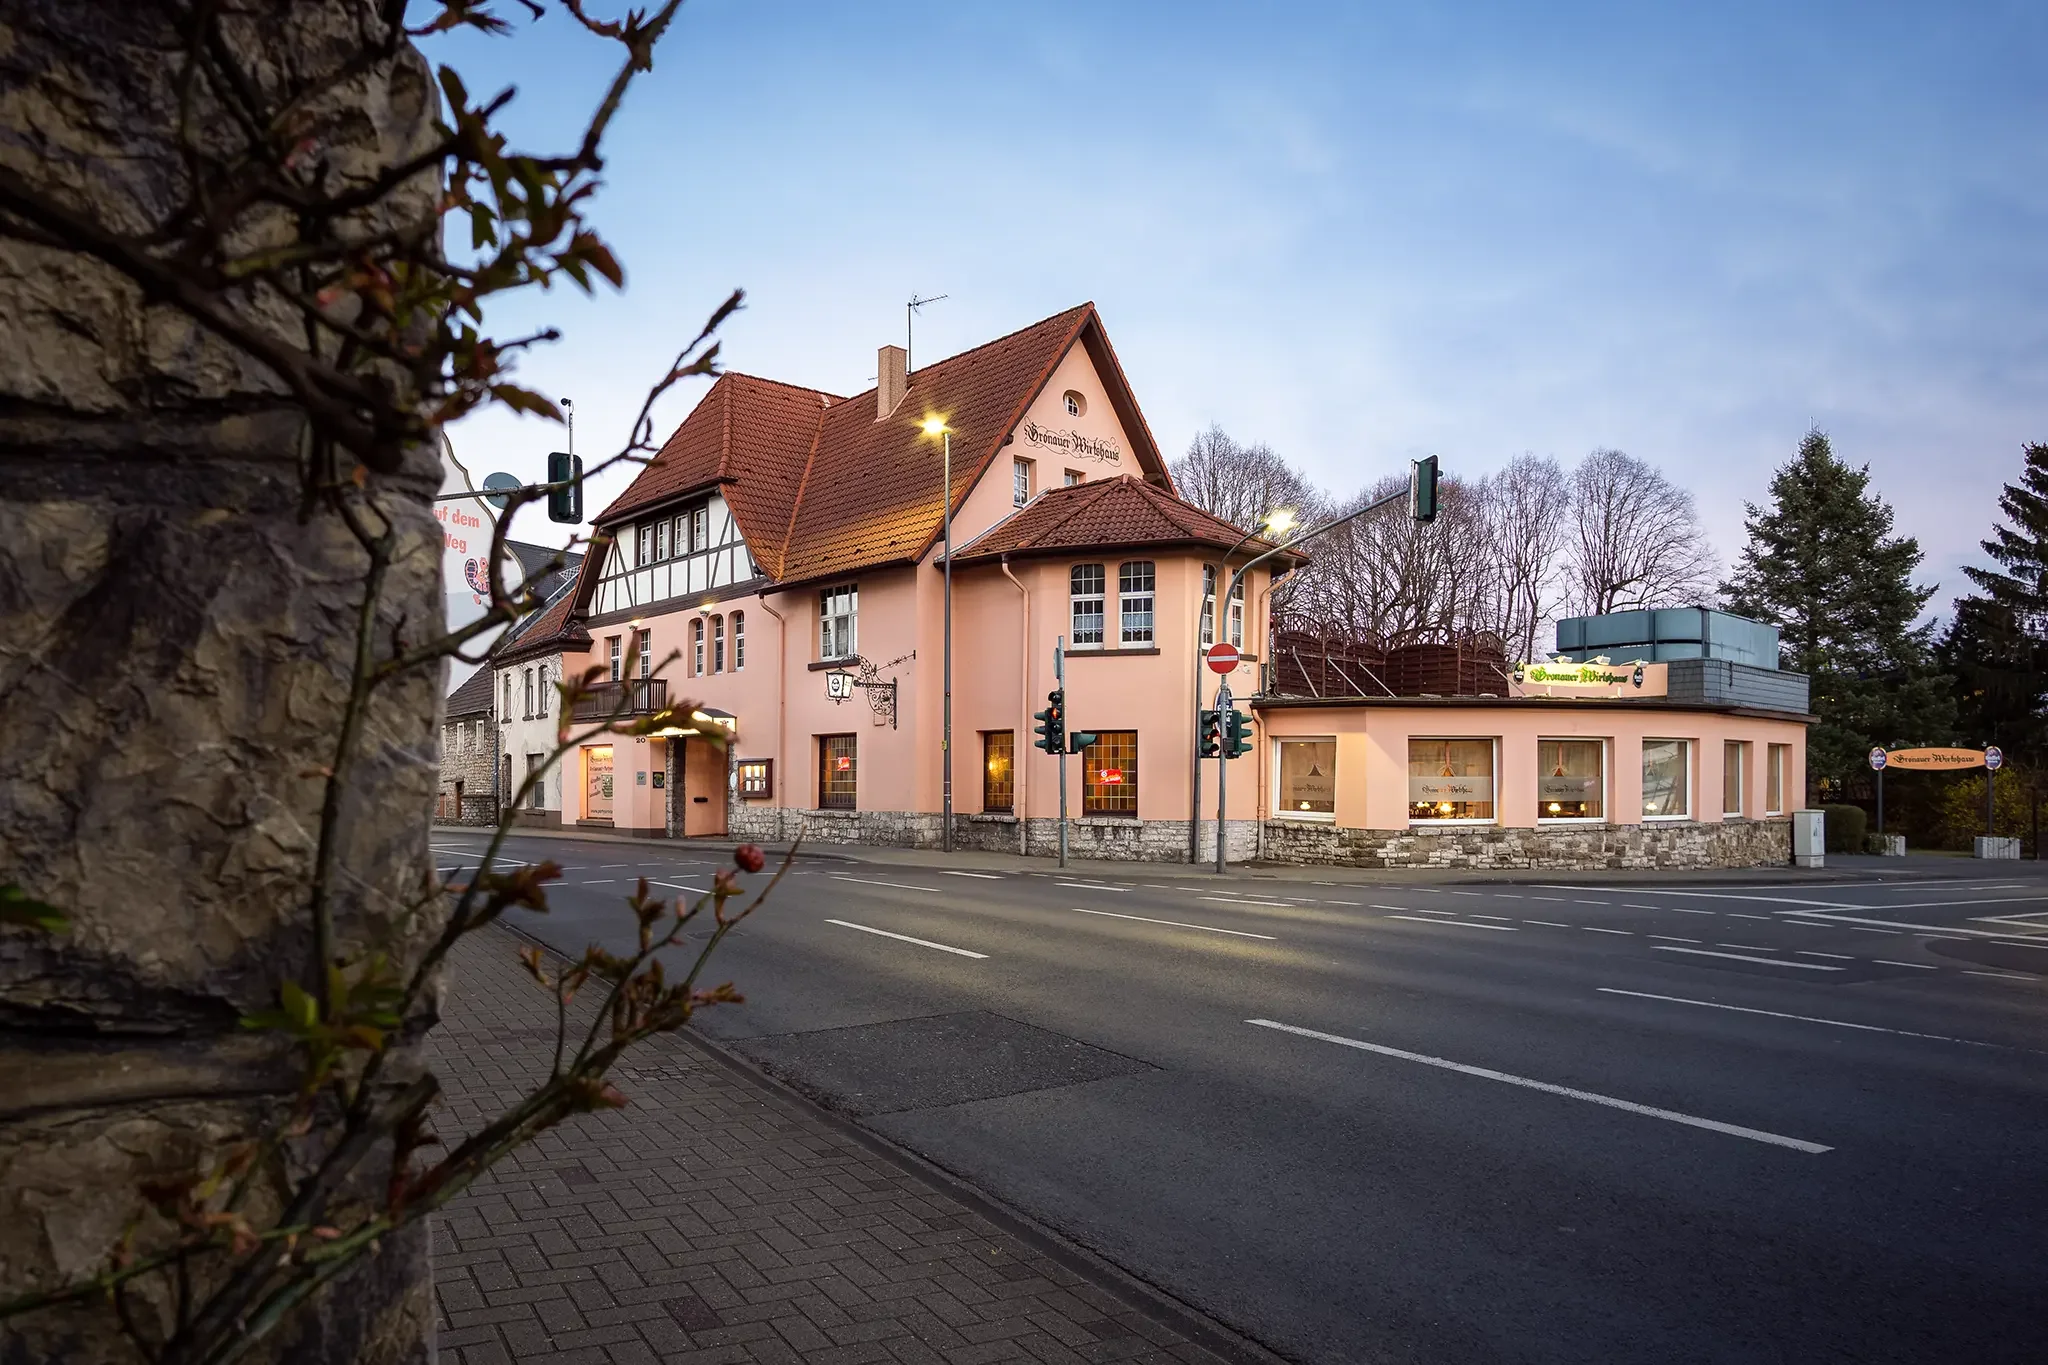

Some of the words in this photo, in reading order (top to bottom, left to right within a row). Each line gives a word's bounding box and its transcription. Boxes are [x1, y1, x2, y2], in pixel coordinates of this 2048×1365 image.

[1024, 422, 1070, 448] Gronauer
[1071, 430, 1120, 461] Wirtshaus
[432, 506, 448, 521] uf
[452, 508, 480, 528] dem
[1530, 666, 1578, 682] Gronauer
[1575, 667, 1628, 685] Wirtshaus
[1893, 754, 1931, 764] Gronauer
[1931, 753, 1975, 764] Wirtshaus
